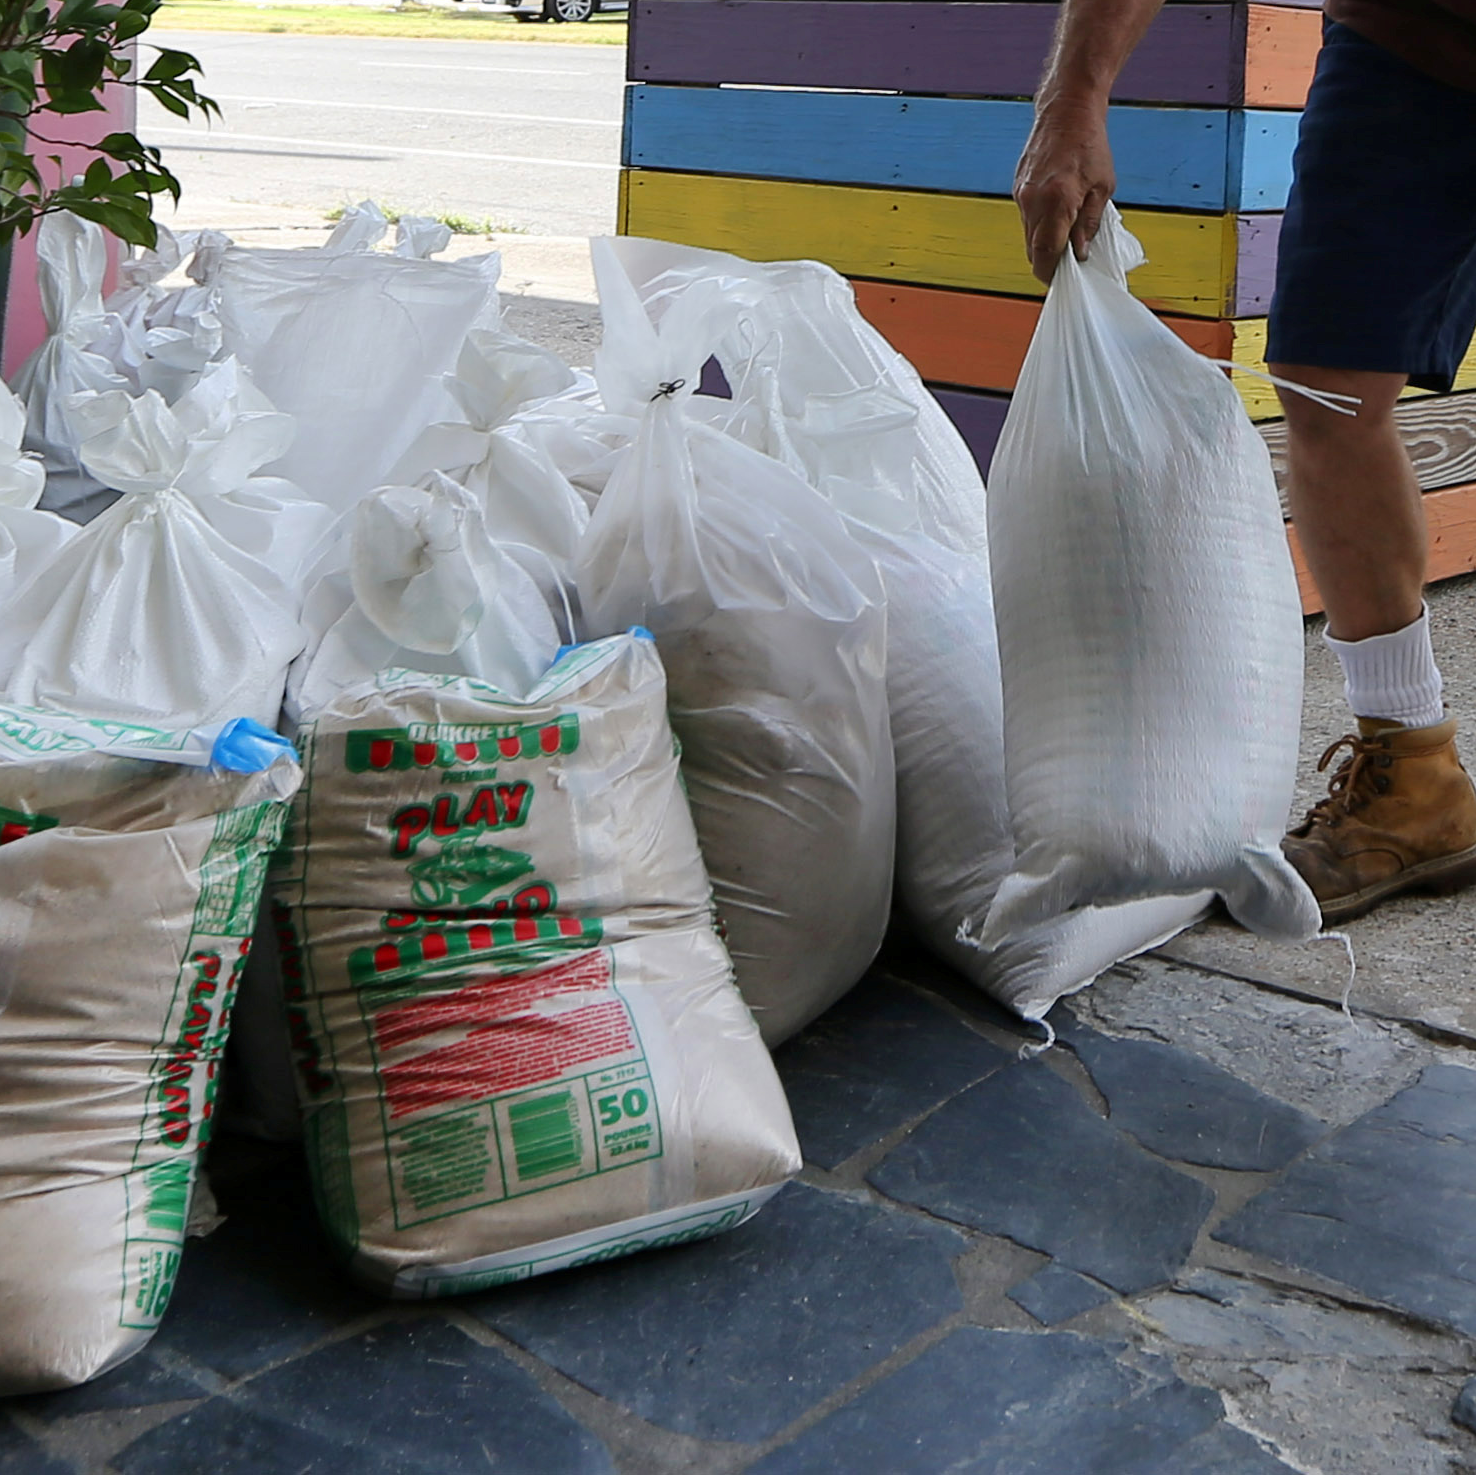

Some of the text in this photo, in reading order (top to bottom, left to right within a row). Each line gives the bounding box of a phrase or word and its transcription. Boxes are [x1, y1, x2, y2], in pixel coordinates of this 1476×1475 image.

[409, 723, 521, 744] QUIKRETE
[440, 767, 498, 784] PREMIUM
[388, 779, 535, 858] PLAY
[380, 880, 558, 934] SD
[179, 950, 223, 1050] PLAY
[598, 1087, 649, 1126] 50
[604, 1122, 652, 1144] POUNDS
[153, 1251, 180, 1317] 50
